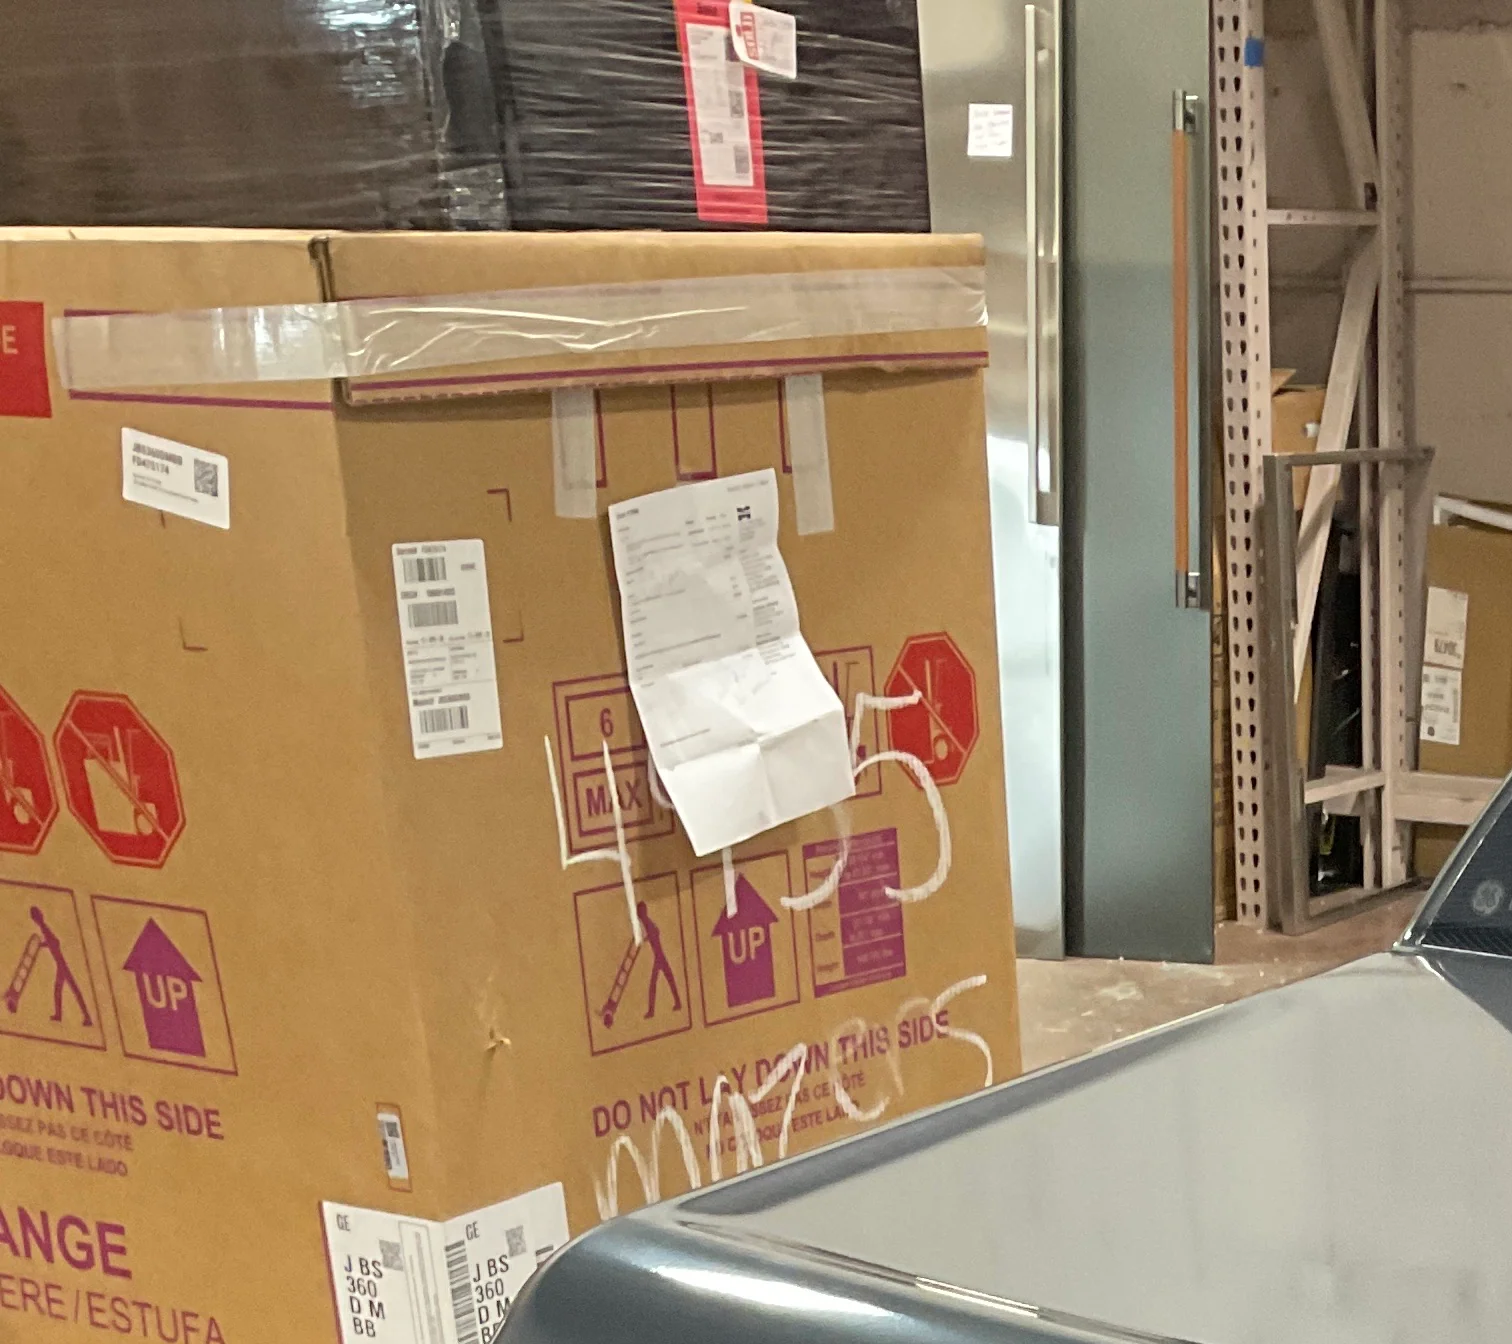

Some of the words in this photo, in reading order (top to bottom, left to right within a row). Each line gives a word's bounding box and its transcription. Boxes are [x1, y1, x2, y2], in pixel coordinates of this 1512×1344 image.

[600, 707, 614, 737] 6
[585, 778, 645, 817] MAX
[727, 926, 766, 966] UP
[142, 972, 187, 1011] UP
[592, 1106, 632, 1137] DO
[640, 1081, 689, 1123] NOT
[837, 1025, 890, 1063] THIS
[897, 1009, 951, 1050] SIDE
[0, 1074, 75, 1114] OWN
[80, 1086, 147, 1126] THIS
[155, 1100, 224, 1140] SIDE
[336, 1213, 350, 1232] GE
[465, 1221, 480, 1241] GE
[344, 1255, 353, 1273] J
[359, 1257, 384, 1279] BS
[473, 1264, 482, 1283] J
[487, 1254, 510, 1277] BS
[346, 1275, 378, 1298] 360
[475, 1278, 505, 1304] 360
[350, 1295, 362, 1314] D
[369, 1300, 386, 1320] M
[478, 1305, 490, 1325] D
[353, 1317, 376, 1338] BB
